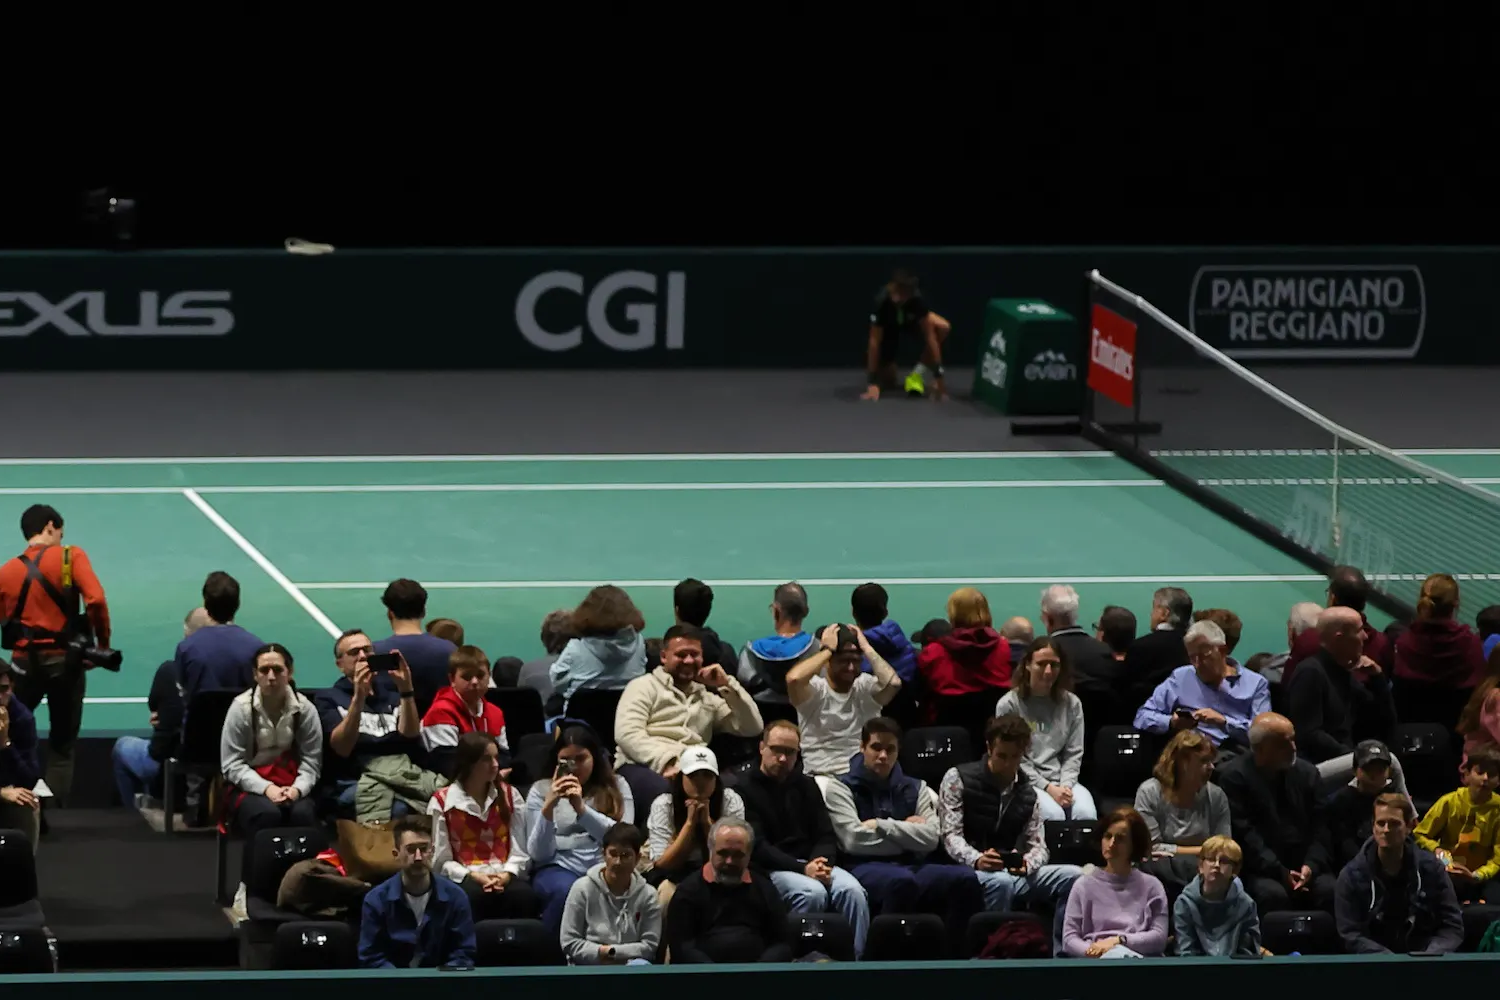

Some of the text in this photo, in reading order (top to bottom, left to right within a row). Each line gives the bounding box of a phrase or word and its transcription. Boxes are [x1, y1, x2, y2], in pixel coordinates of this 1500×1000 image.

[1211, 277, 1405, 308] PARMIGIANO
[515, 270, 686, 352] CGI
[1229, 310, 1385, 342] REGGIANO
